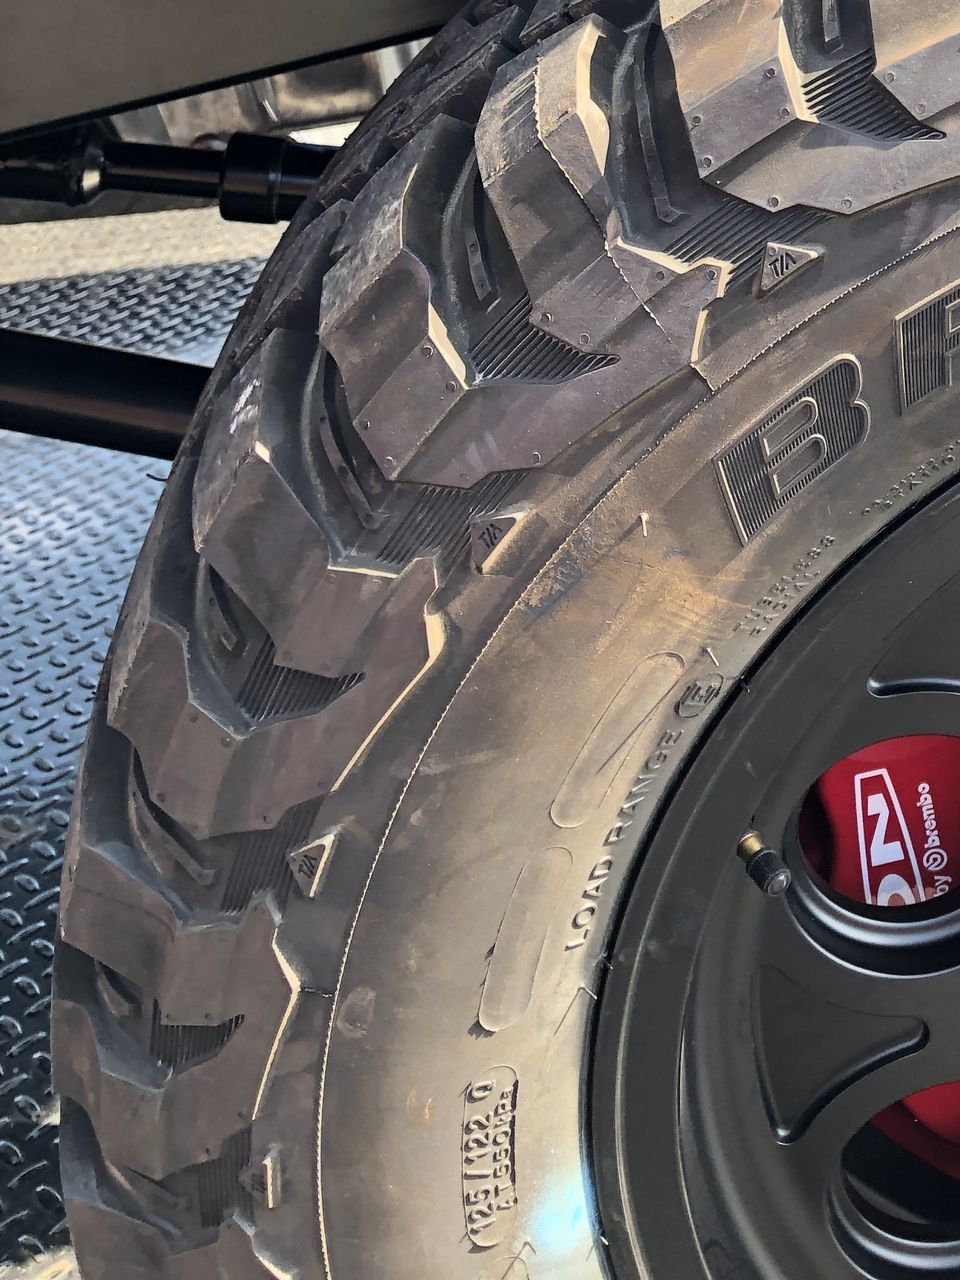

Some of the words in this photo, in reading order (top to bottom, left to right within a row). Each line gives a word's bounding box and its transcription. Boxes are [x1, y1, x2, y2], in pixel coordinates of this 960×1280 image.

[768, 251, 797, 279] T/A
[564, 855, 615, 952] LOAD
[602, 729, 684, 849] RANGE
[917, 782, 940, 849] brembo
